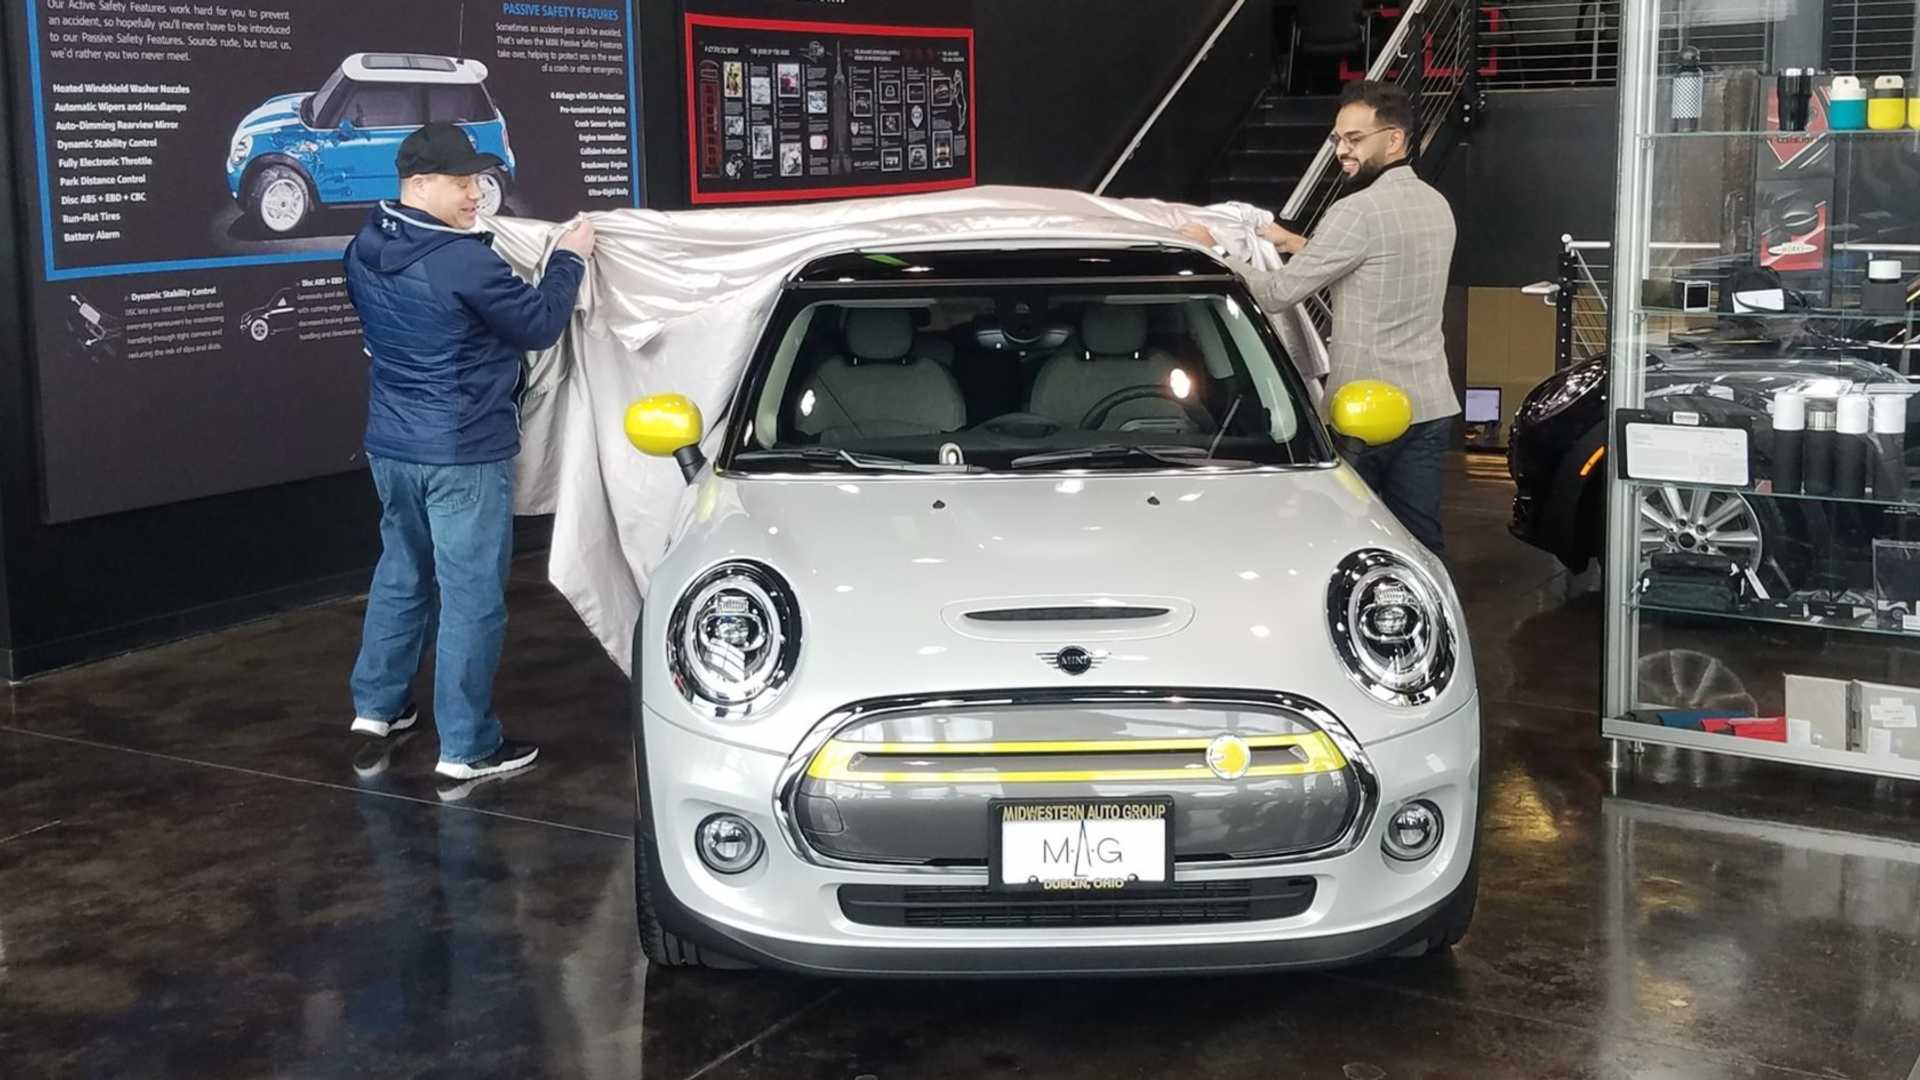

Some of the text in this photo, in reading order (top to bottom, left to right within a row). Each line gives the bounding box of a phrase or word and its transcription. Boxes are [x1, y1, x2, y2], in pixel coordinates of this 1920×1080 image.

[48, 0, 290, 20] Our Active Safety Features work hard for you to prevent
[503, 3, 619, 20] PASSIVE SAFETY FEATURES
[48, 15, 291, 35] an accident, so hopefully you'll never have to be introduced
[49, 32, 60, 42] to
[63, 34, 79, 42] our
[82, 32, 114, 44] Passive
[117, 33, 144, 46] Safety
[147, 34, 186, 46] Features.
[188, 35, 218, 47] Sounds
[244, 38, 258, 49] but
[260, 40, 279, 50] trust
[51, 47, 192, 61] we'd rather you two never meet.
[53, 84, 190, 94] Heated Windshield Washer Nozzles
[55, 102, 188, 113] Automatic Wipers and Headlamps
[56, 120, 179, 132] Auto-Dimming Rearview Mirror
[57, 138, 158, 151] Dynamic Stability Control
[59, 156, 153, 169] Fully Electronic Throttle
[60, 174, 147, 187] Park Distance Control
[61, 195, 80, 206] Disc
[80, 194, 97, 204] ABS
[105, 193, 122, 203] EBD
[130, 192, 147, 202] CBC
[63, 212, 121, 224] Run-Flat Tires
[64, 230, 121, 243] Battery Alarm
[131, 286, 217, 302] Dynamic Stability Control
[1061, 655, 1088, 665] MINI
[1002, 804, 1166, 821] MIDWESTERN AUTO GROUP
[1043, 877, 1125, 890] DUBLIN, OHIO
